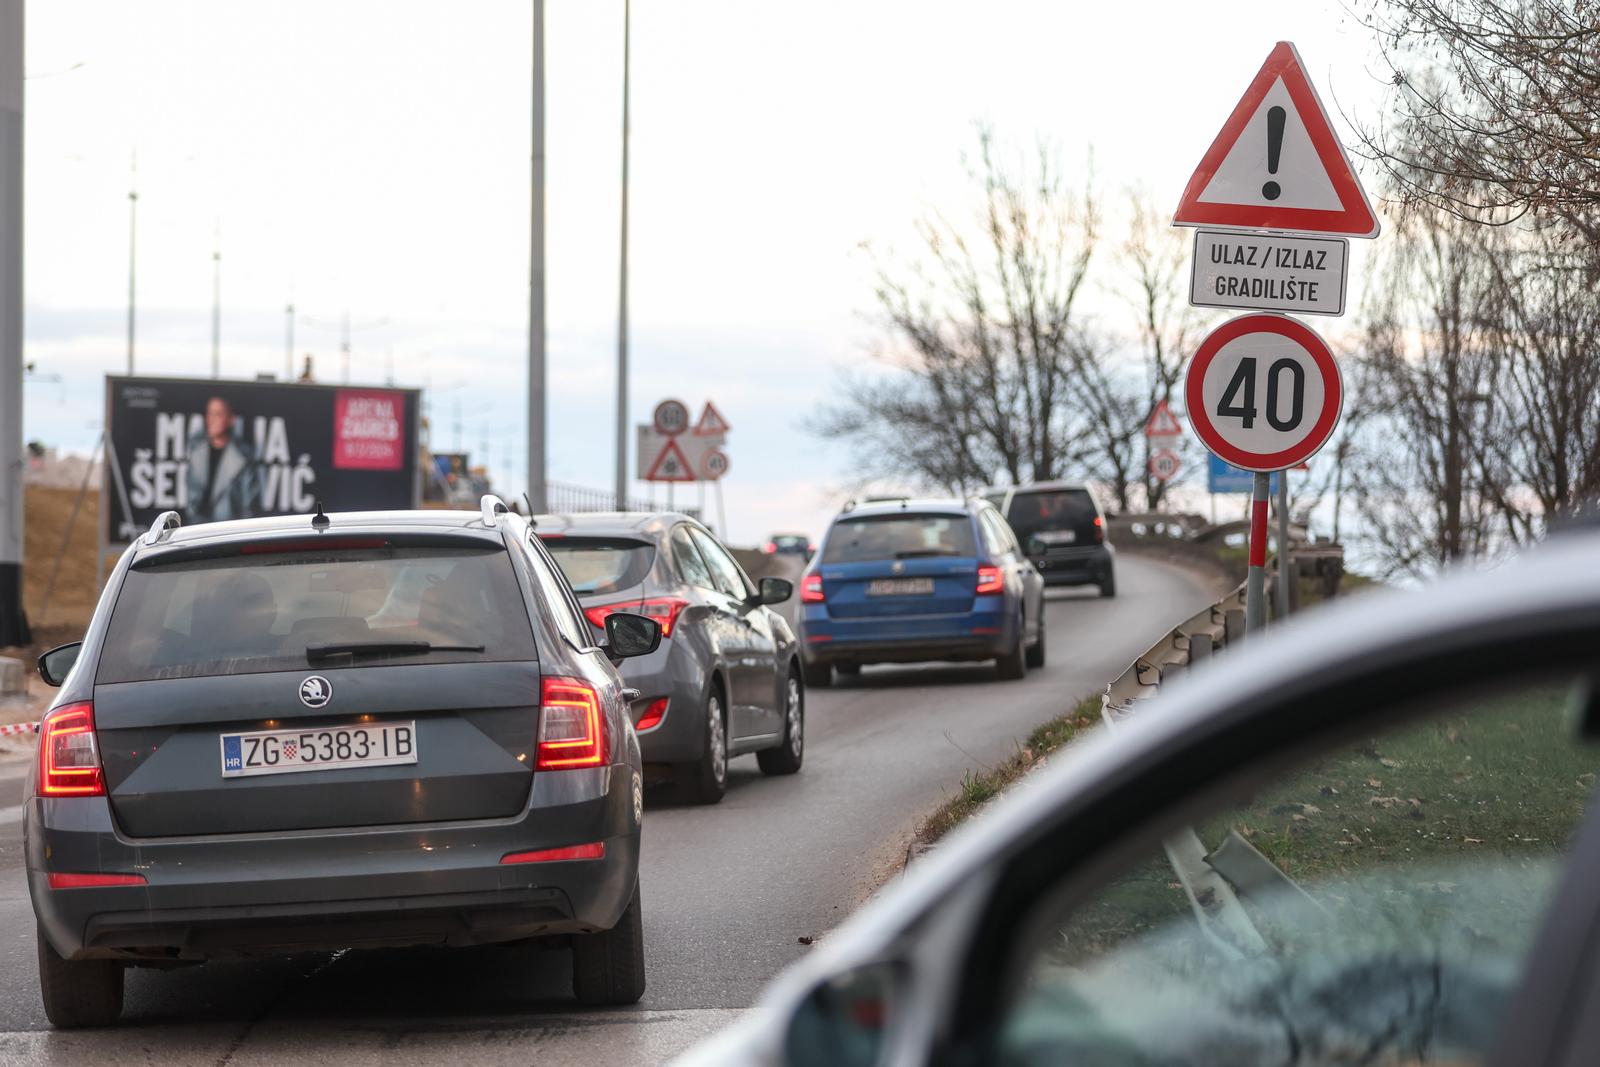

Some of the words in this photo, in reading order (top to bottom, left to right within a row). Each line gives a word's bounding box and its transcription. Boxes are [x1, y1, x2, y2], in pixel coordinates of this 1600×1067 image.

[1215, 275, 1319, 302] GRADILIŠTE
[1216, 357, 1305, 432] 40
[226, 758, 241, 767] HR
[244, 736, 280, 767] ZG
